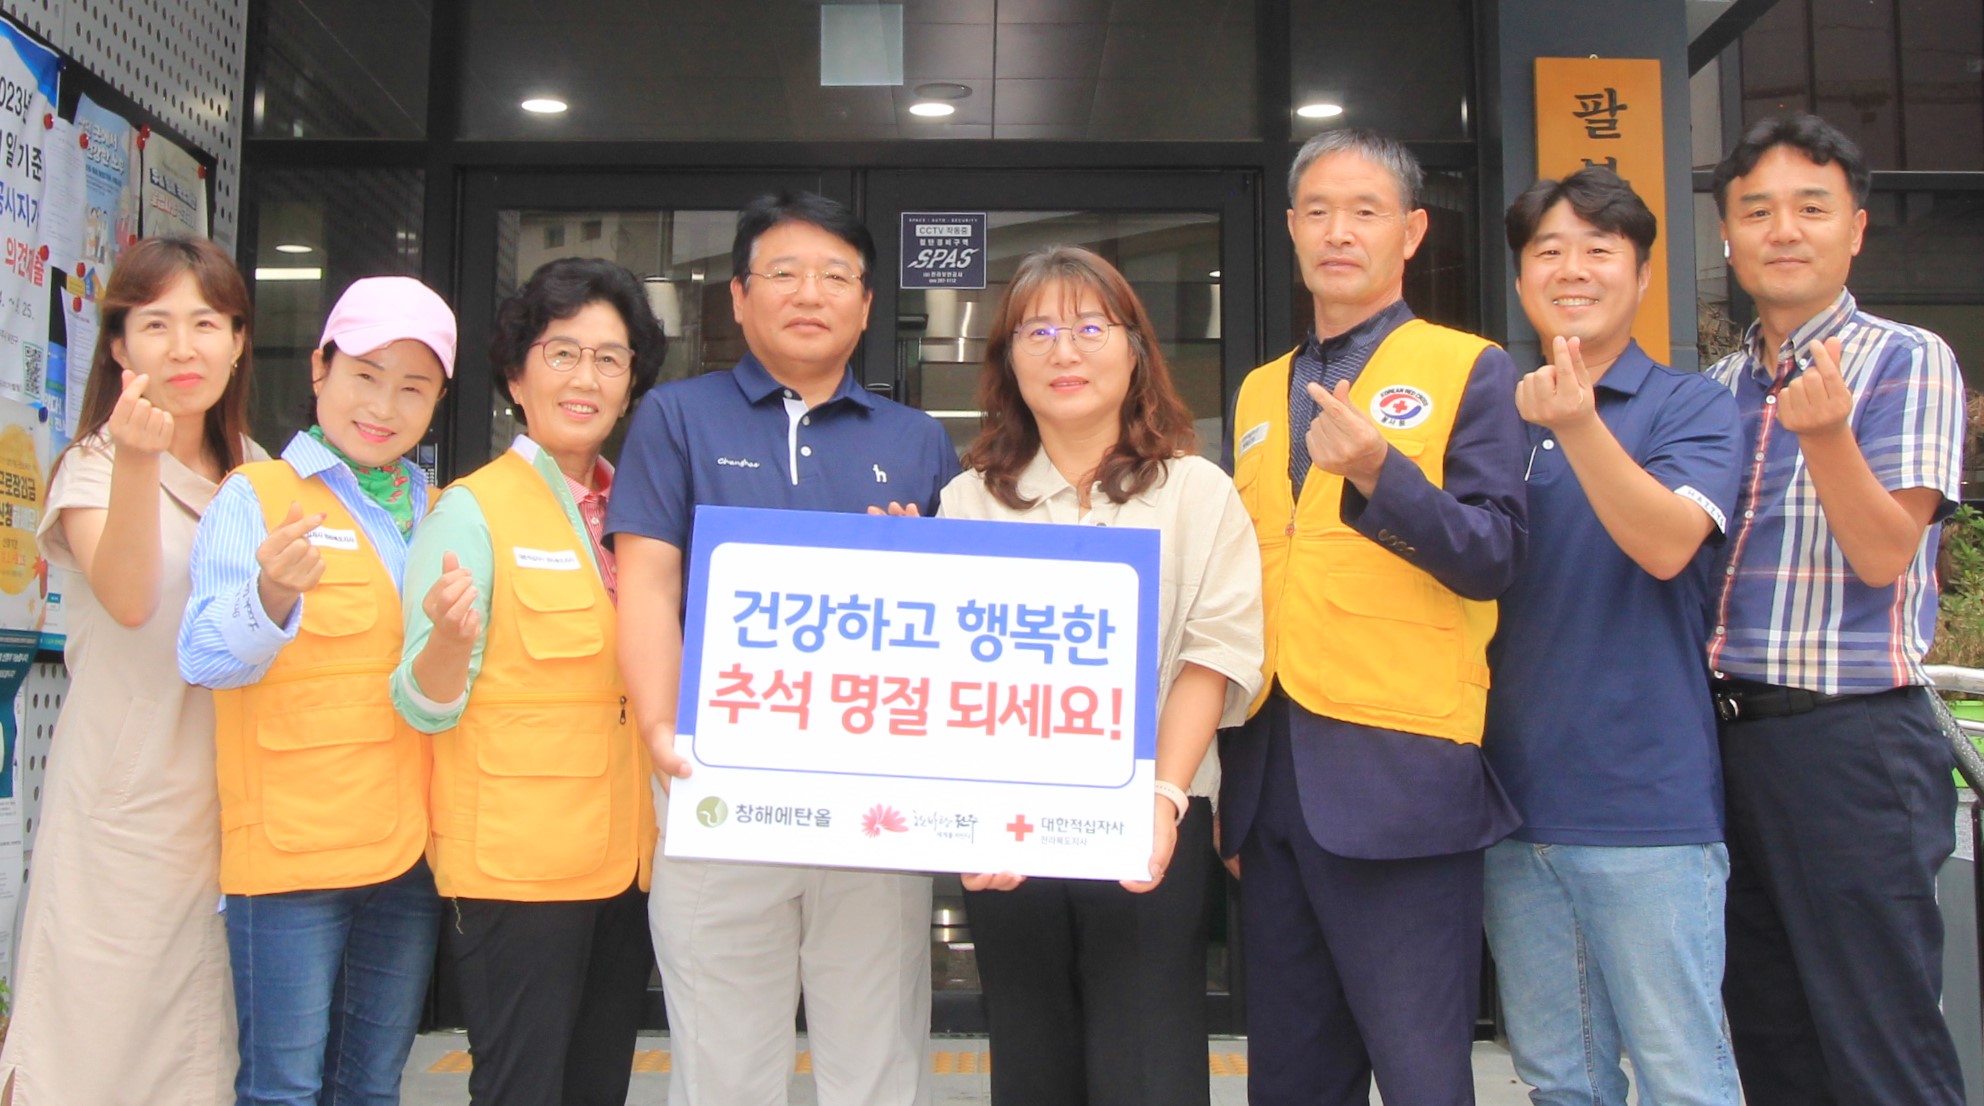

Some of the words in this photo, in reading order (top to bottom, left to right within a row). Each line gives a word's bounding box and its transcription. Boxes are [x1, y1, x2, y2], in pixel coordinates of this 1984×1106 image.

[919, 226, 944, 235] CCTV
[907, 248, 979, 269] SPAS
[1380, 388, 1404, 398] KOREAN
[1404, 388, 1416, 396] RED
[733, 591, 940, 653] 건강하고
[957, 599, 1116, 666] 행복한
[709, 663, 813, 730] 추석
[830, 673, 931, 736] 명절
[946, 682, 1124, 741] 되세요!
[735, 803, 832, 828] 창해에탄올
[1041, 816, 1125, 836] 대한적십자사
[1040, 835, 1088, 846] 전라북도지사
